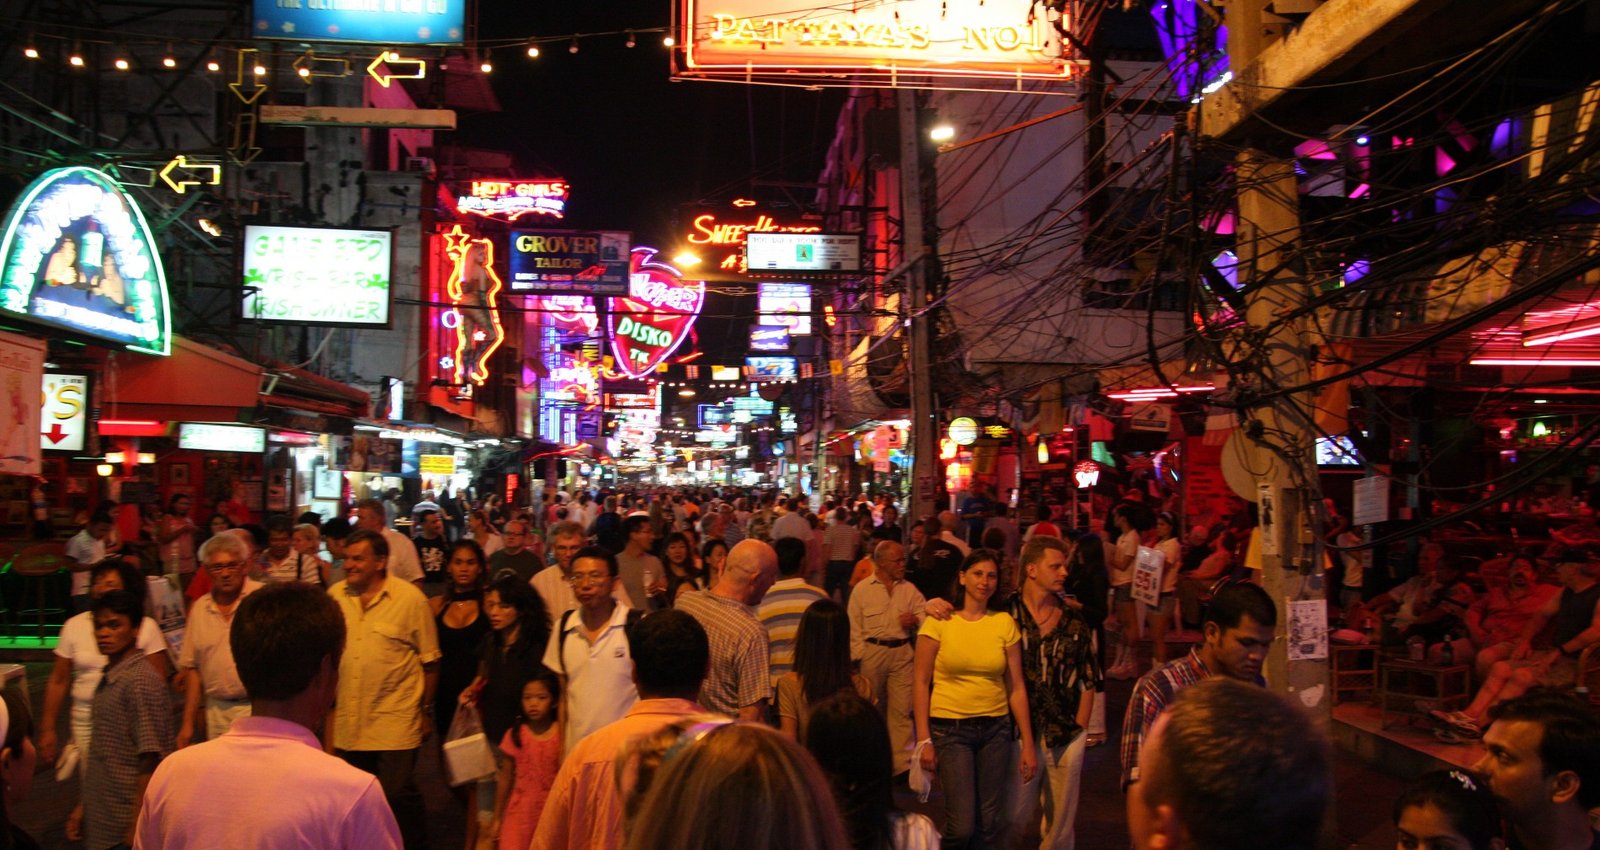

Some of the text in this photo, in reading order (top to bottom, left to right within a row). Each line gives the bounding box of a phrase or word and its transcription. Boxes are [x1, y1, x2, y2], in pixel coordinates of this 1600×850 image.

[514, 183, 565, 197] GIRLS
[515, 235, 598, 254] GROVER
[534, 257, 583, 269] TAILOR
[616, 316, 673, 347] DISKO
[629, 348, 651, 364] TK
